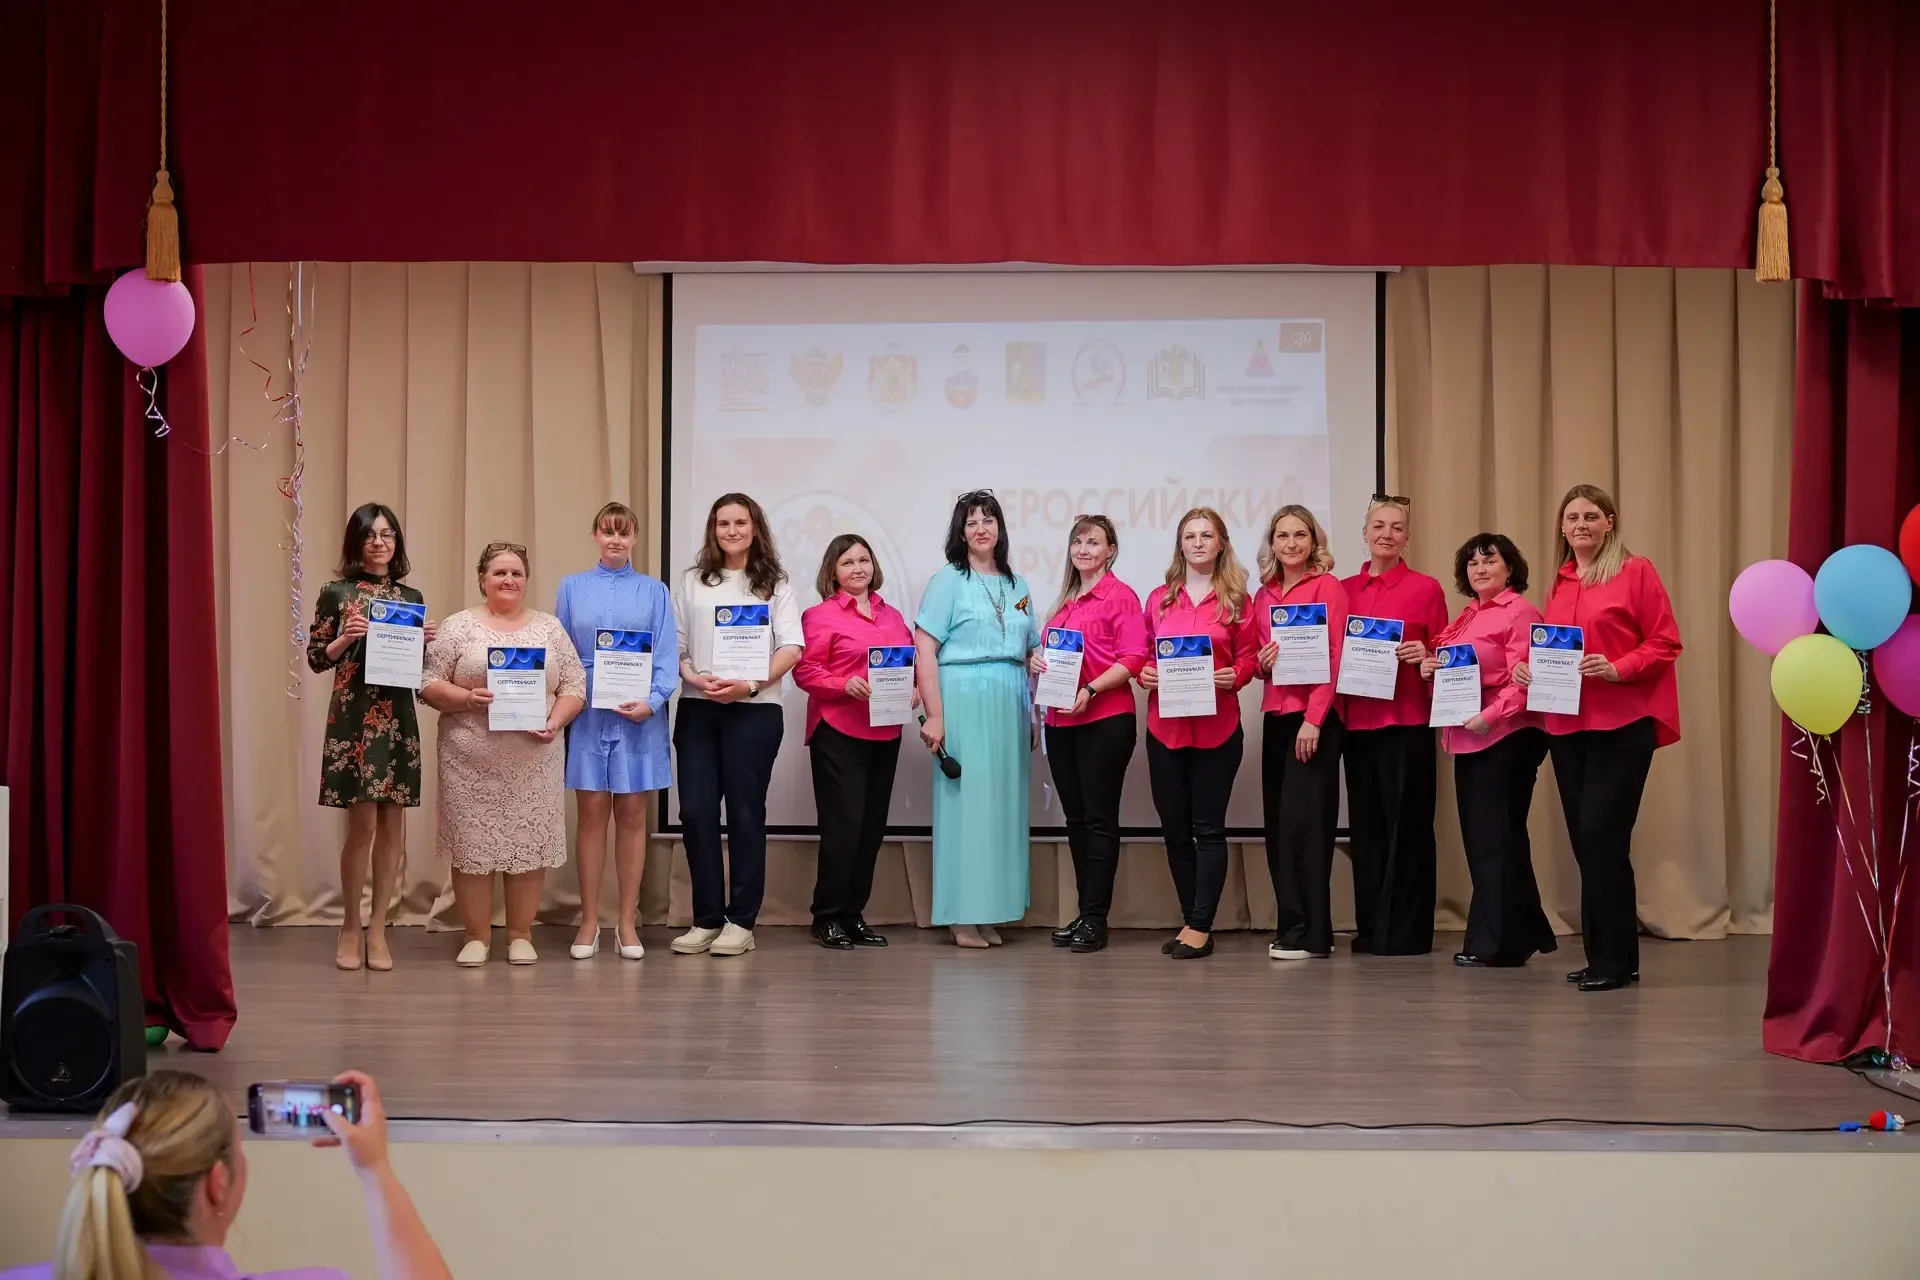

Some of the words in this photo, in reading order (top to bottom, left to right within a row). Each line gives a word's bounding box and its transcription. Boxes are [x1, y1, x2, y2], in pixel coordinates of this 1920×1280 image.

[950, 475, 1304, 531] ЕРОССИЙСКИЙ
[1351, 646, 1391, 655] СЕРТИФИКАТ
[1166, 666, 1205, 674] СЕРТИФИКАТ
